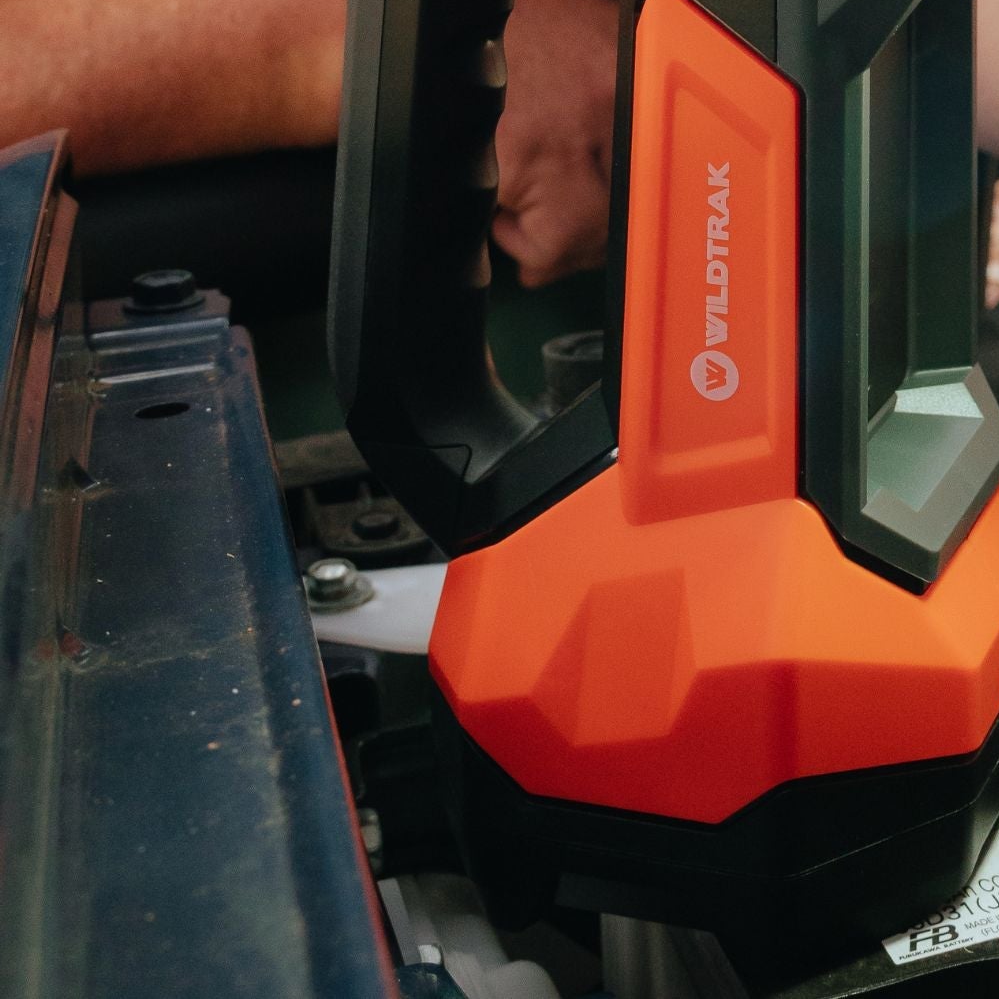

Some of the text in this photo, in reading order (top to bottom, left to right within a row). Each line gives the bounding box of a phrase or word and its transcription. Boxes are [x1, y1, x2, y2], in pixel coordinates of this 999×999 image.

[705, 161, 730, 347] WILDTRAK
[964, 917, 994, 930] MADE
[943, 937, 974, 949] BATTERY
